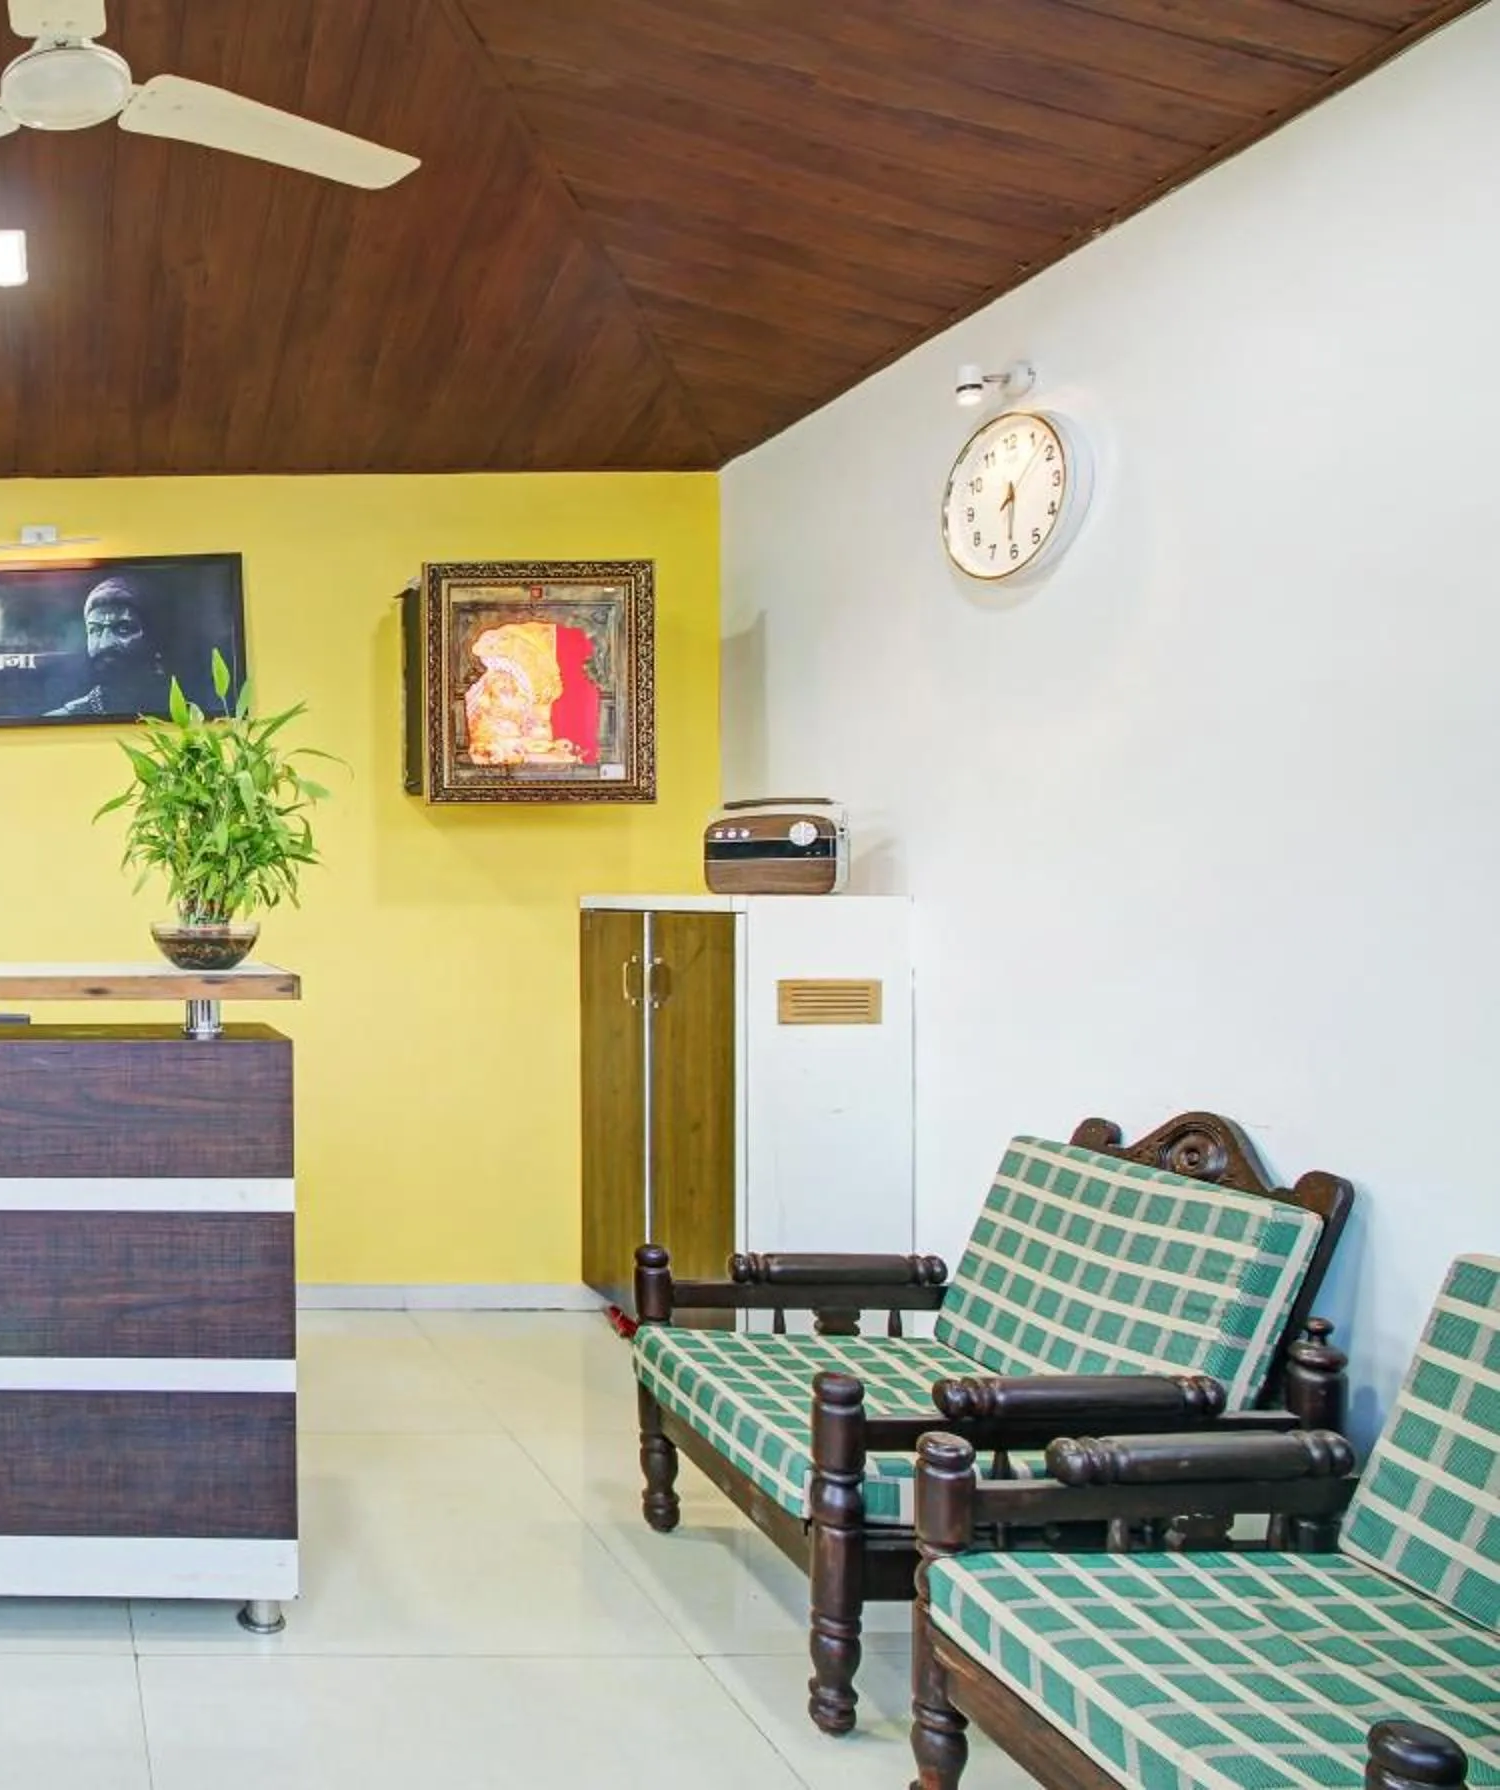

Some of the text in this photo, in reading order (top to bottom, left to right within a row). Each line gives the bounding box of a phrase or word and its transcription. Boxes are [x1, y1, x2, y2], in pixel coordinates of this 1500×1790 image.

[1003, 433, 1017, 450] 12
[1029, 431, 1035, 447] 1
[984, 451, 996, 469] 11
[1044, 444, 1055, 461] 2
[968, 477, 983, 496] 10
[1052, 469, 1061, 487] 3
[967, 507, 975, 523] 9
[1047, 500, 1057, 517] 4
[973, 531, 981, 547] 8
[1031, 528, 1041, 545] 5
[988, 543, 997, 560] 7
[1010, 544, 1019, 560] 6
